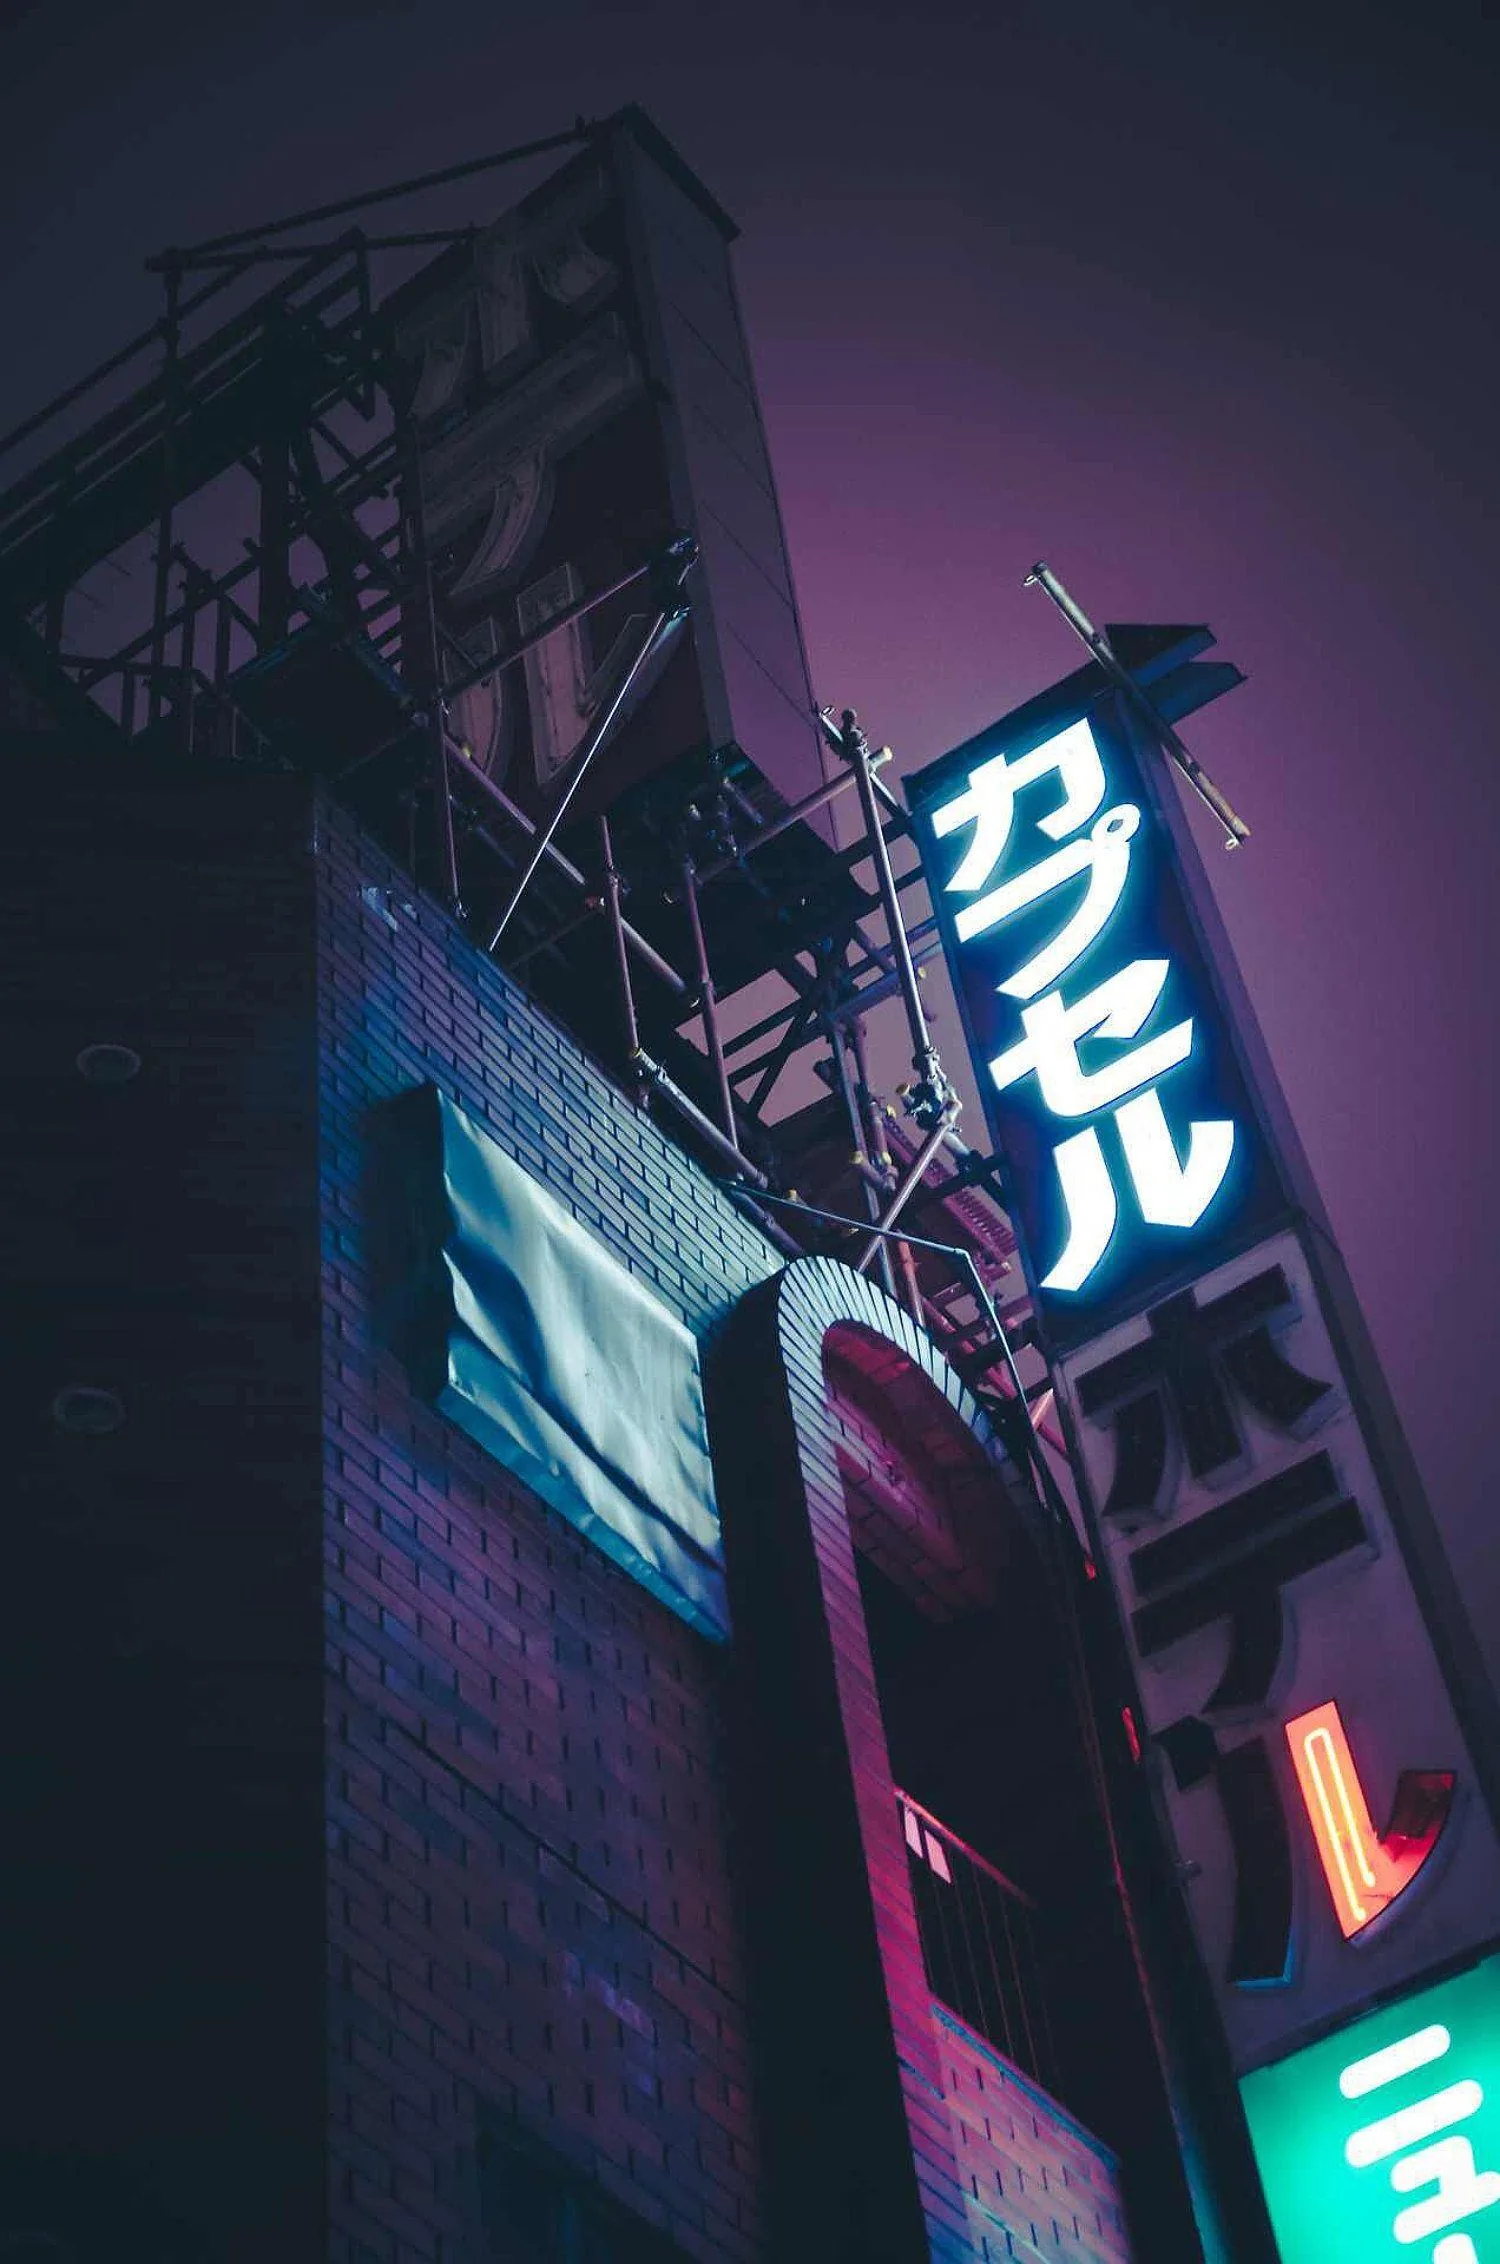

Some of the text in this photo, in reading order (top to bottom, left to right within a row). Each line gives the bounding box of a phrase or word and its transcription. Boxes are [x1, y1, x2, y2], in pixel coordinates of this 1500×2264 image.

[930, 716, 1235, 1292] カプセル
[1074, 1262, 1459, 1986] ホテル
[1339, 2024, 1500, 2264] ニュ
